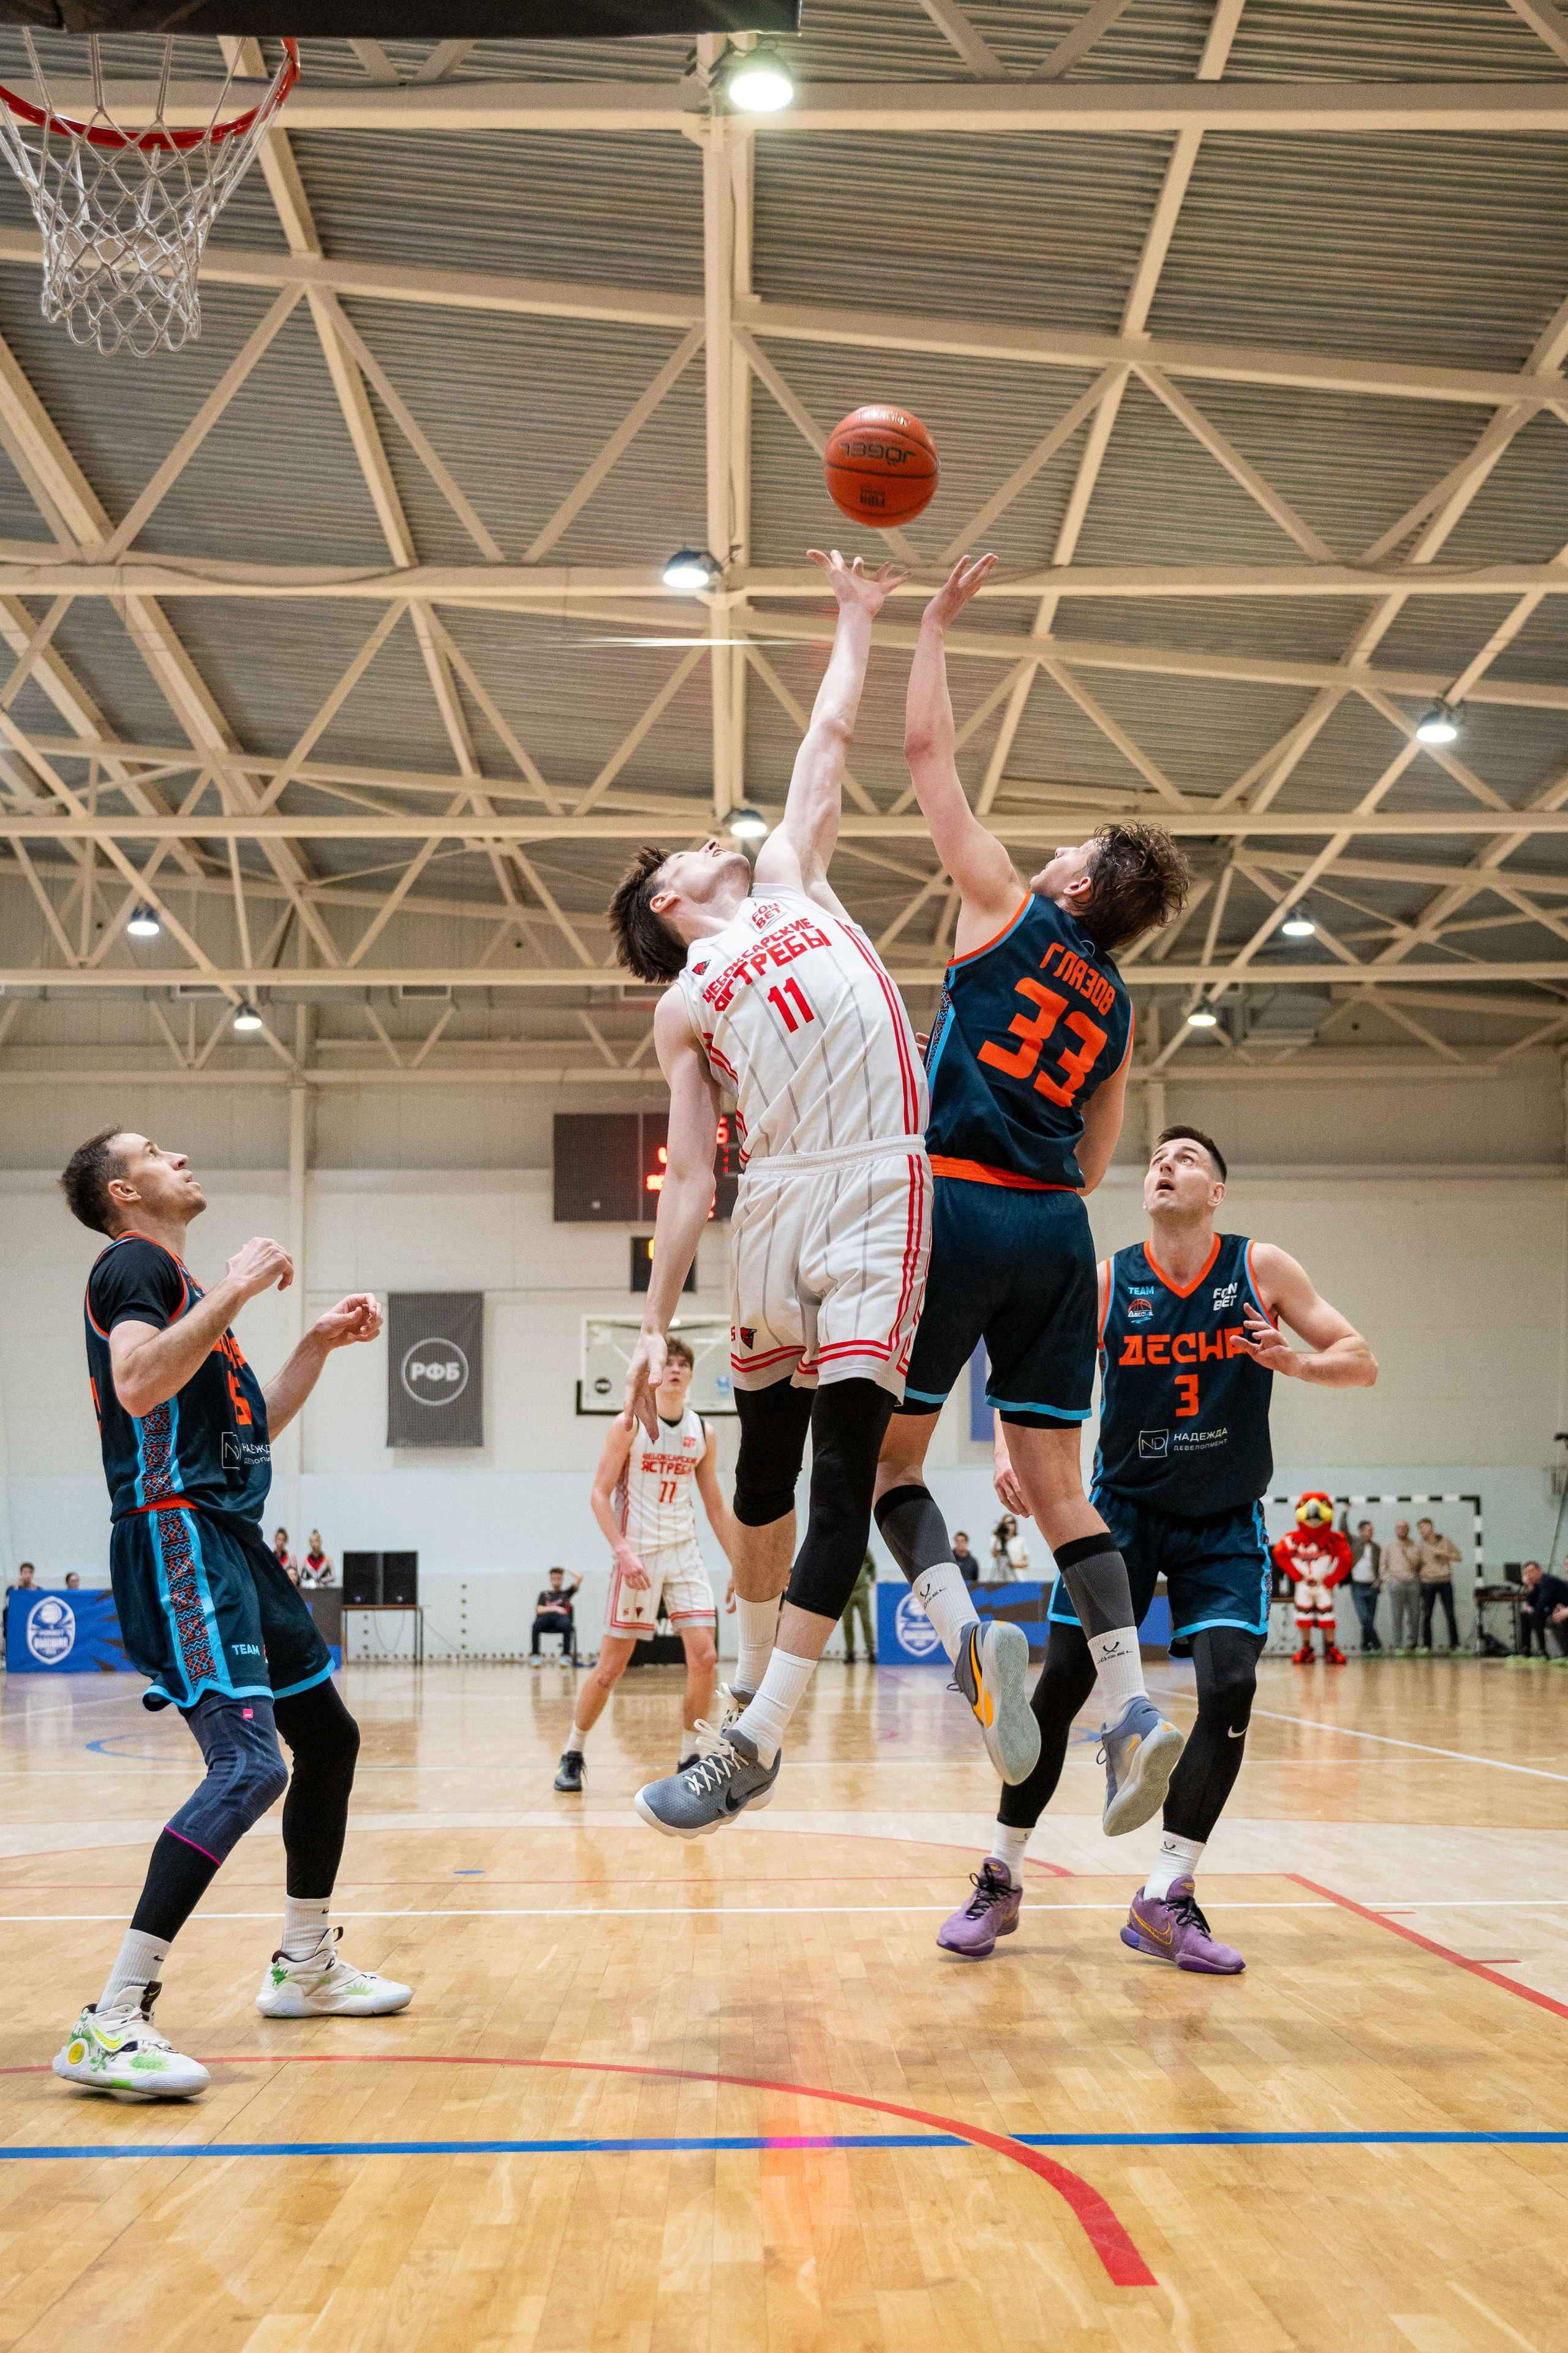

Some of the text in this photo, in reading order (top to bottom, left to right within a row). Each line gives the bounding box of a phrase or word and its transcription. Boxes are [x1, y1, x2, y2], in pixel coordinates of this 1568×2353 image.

[841, 443, 916, 466] JÖGEL
[752, 903, 778, 923] FON
[756, 907, 780, 929] BET
[702, 918, 815, 1003] ЧЕБОКСАРСКИЕ
[1039, 942, 1115, 1016] ГЛАЗОВ
[767, 976, 815, 1033] 11
[977, 977, 1108, 1108] 33
[1128, 1286, 1154, 1295] TEAM
[1213, 1282, 1238, 1299] FON
[1213, 1295, 1237, 1311] BET
[411, 1361, 460, 1382] РФБ
[1174, 1374, 1199, 1417] 3
[1174, 1427, 1227, 1441] НАДЕЖДА
[1174, 1438, 1227, 1451] ДЕВЕЛОПМЕНТ
[232, 1644, 260, 1656] TEAM
